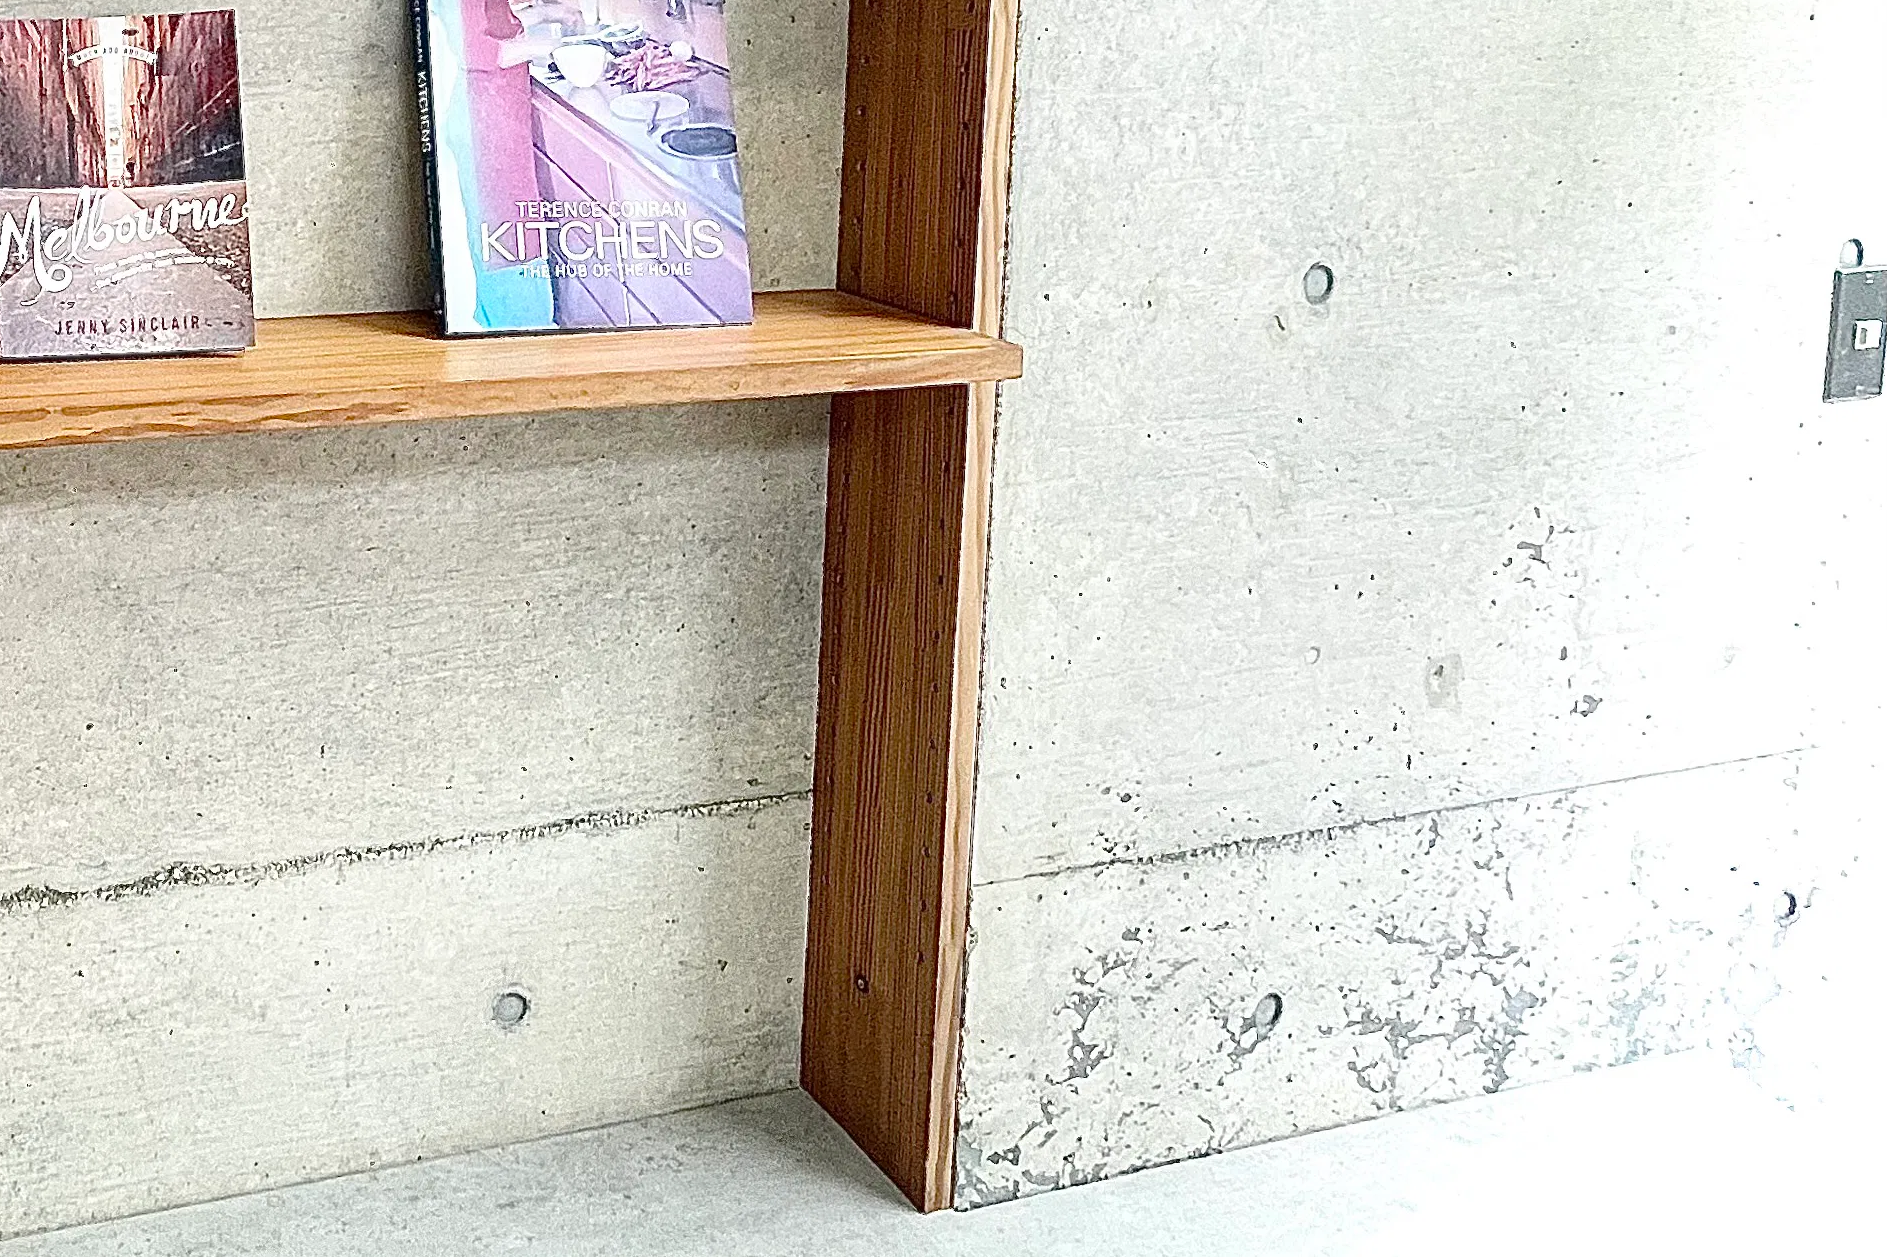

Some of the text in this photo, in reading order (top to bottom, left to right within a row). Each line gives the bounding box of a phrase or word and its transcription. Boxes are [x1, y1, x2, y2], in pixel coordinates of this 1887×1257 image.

[417, 71, 432, 154] KITCHENS
[515, 199, 688, 219] TERENCE CONRAN
[480, 218, 725, 262] KITCHENS
[522, 260, 693, 278] THE HUB OF THE HOME
[54, 315, 200, 336] JENNY SINCLAIR
